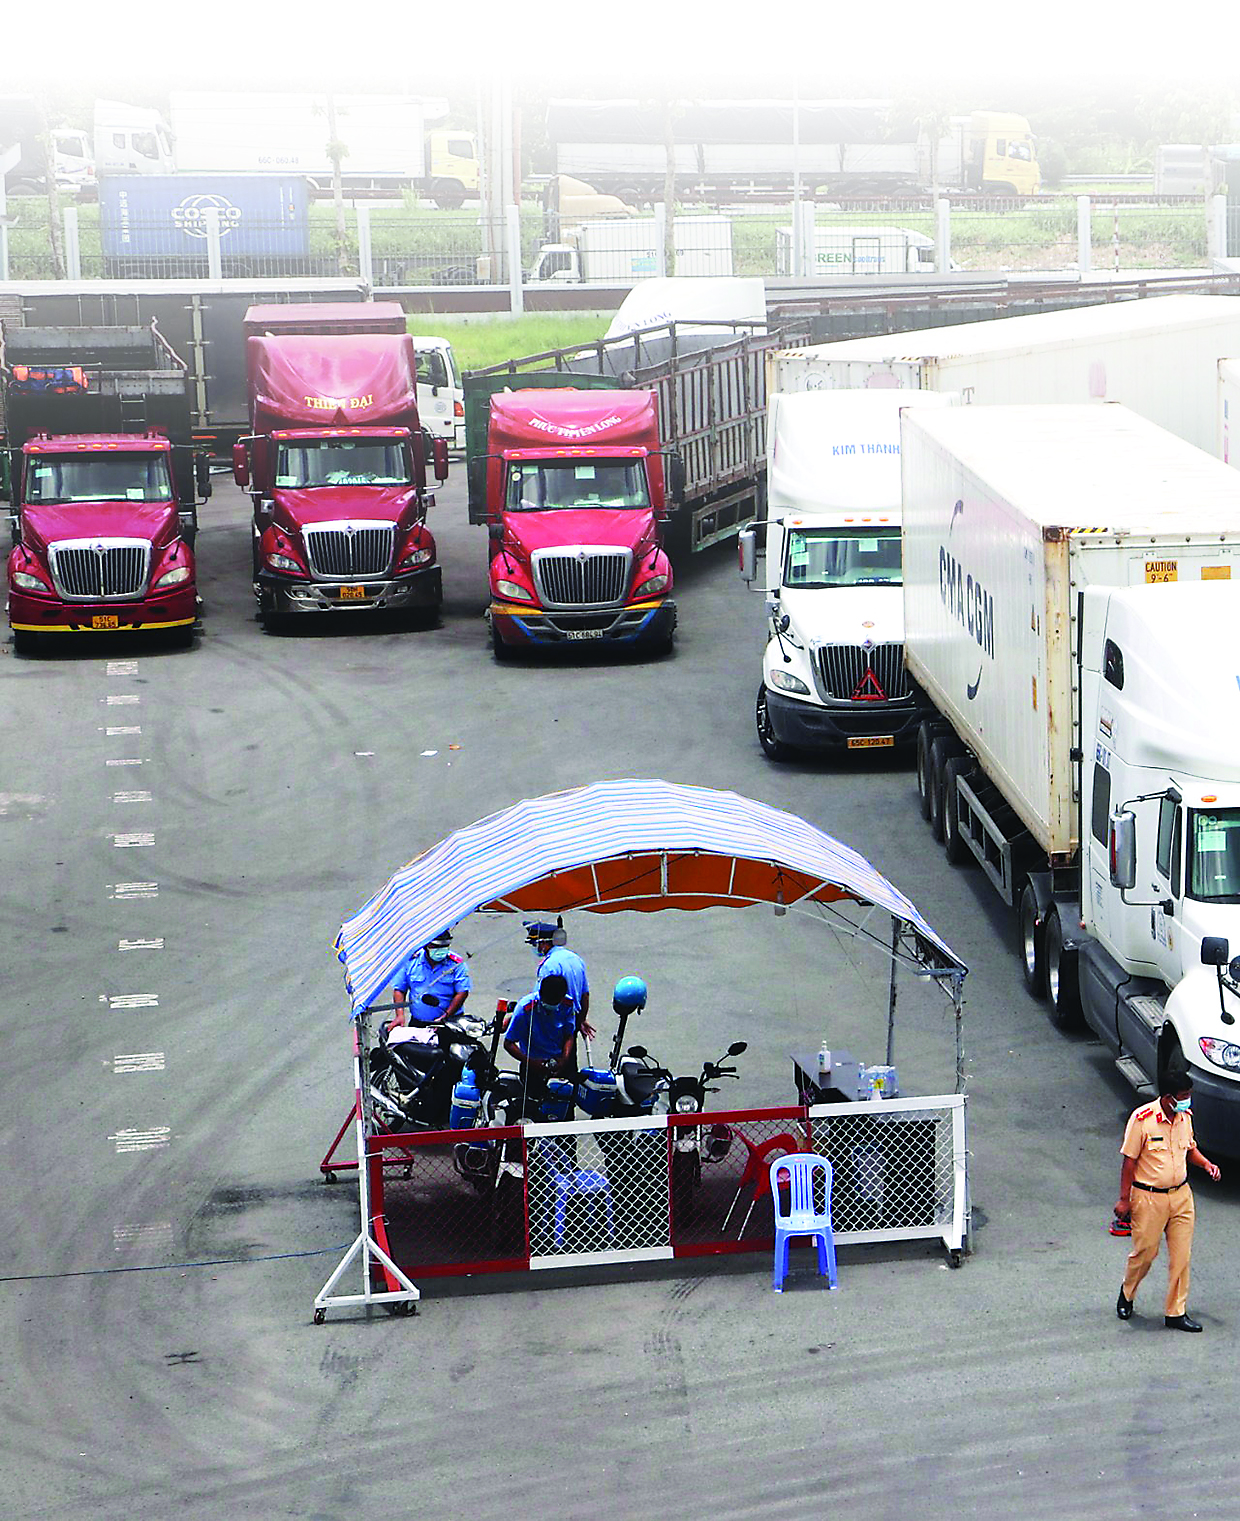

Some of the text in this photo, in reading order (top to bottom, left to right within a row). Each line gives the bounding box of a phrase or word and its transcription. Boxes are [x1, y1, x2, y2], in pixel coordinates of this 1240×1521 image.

[174, 220, 240, 228] SHIPING
[815, 252, 852, 263] REEN
[595, 415, 623, 431] LONG
[832, 445, 856, 456] KIM
[1145, 561, 1177, 573] CAUTION
[938, 545, 995, 661] CMA CGM
